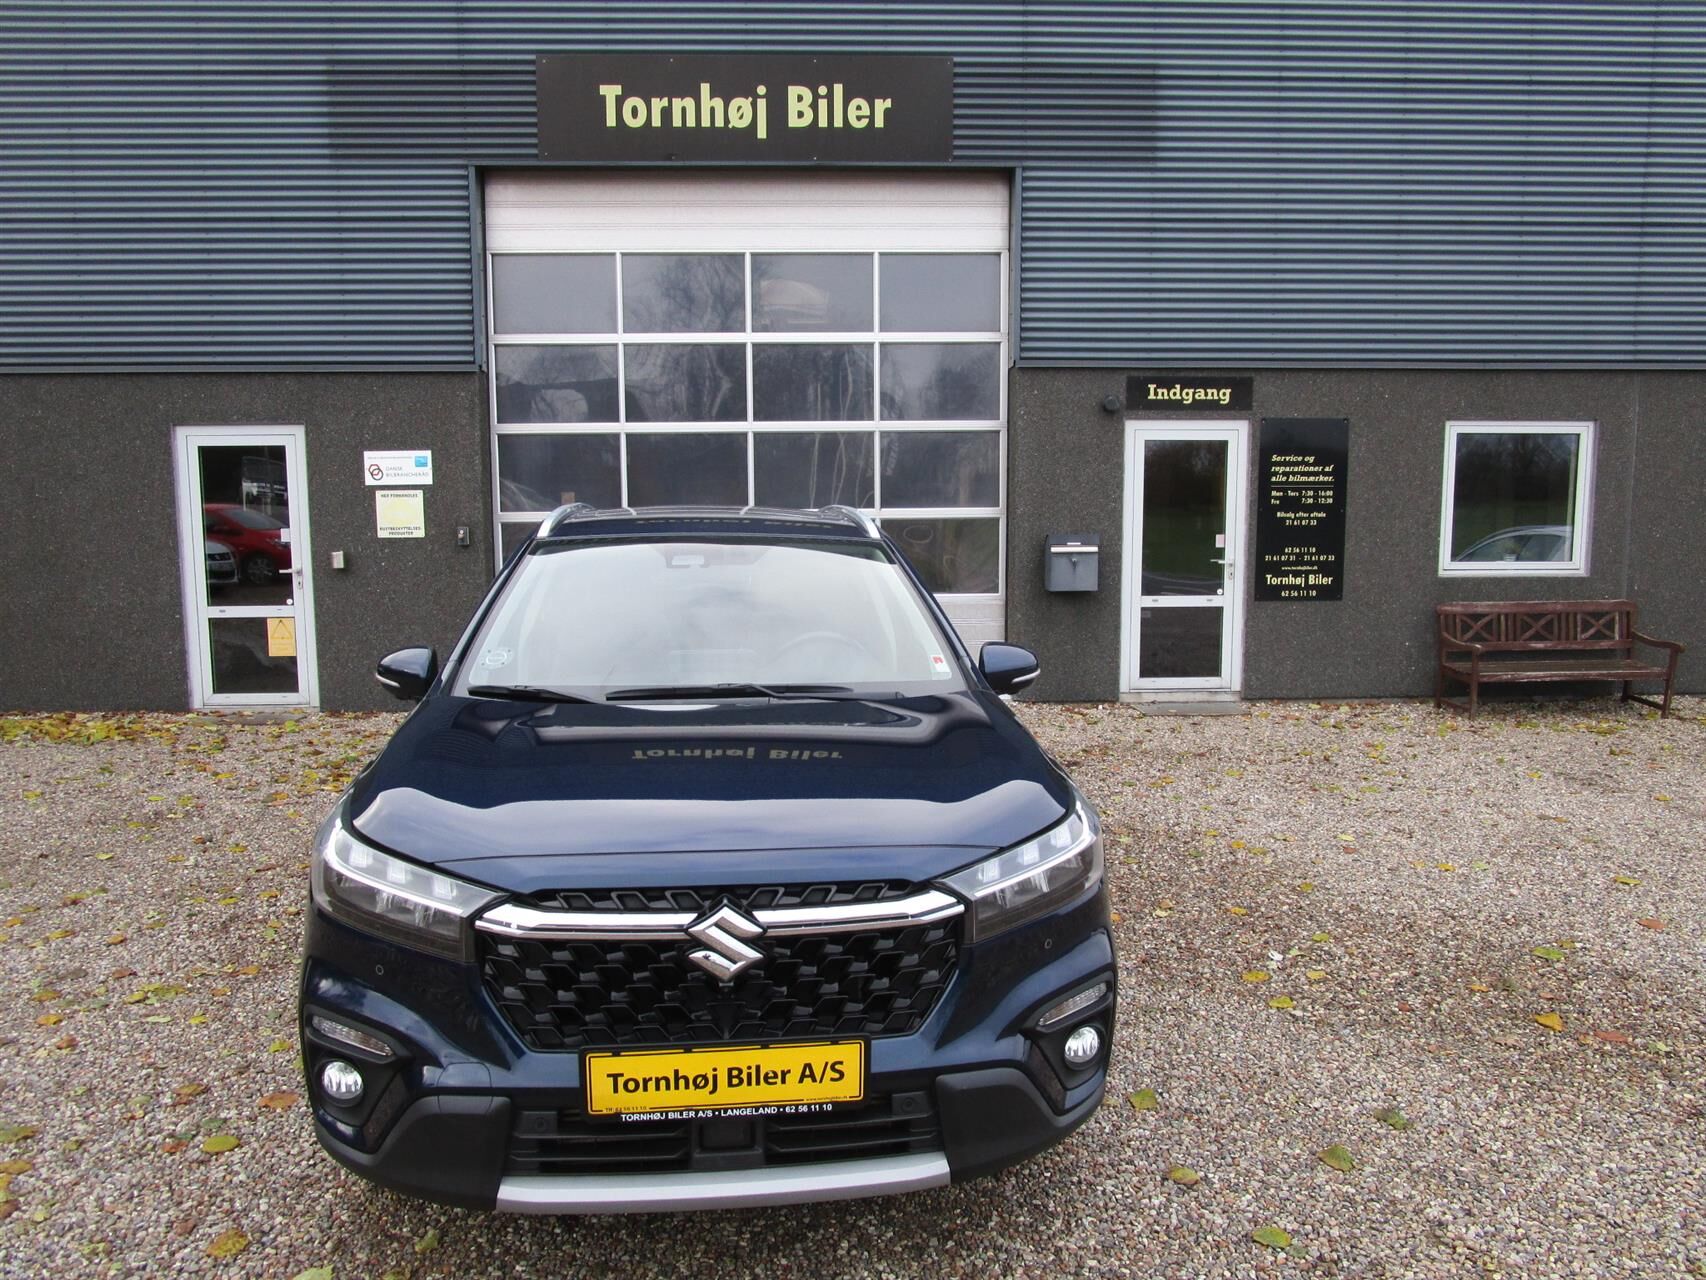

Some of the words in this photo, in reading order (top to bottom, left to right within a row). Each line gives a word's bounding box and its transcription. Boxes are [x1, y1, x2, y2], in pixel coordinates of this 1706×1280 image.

[599, 83, 767, 139] Tornhøj
[787, 83, 892, 128] Biler
[1147, 384, 1232, 404] Indgang
[1271, 454, 1302, 462] Service
[1271, 465, 1323, 473] reparationer
[1324, 464, 1334, 472] af
[1288, 474, 1335, 482] bilmærker.
[1265, 574, 1305, 587] Tornhøj
[1308, 574, 1333, 585] Biler
[606, 1067, 718, 1095] Tornhøj
[727, 1064, 791, 1089] Biler
[797, 1060, 846, 1084] A/S
[621, 1112, 666, 1122] TORNHØJ
[668, 1110, 696, 1119] BILER
[698, 1109, 713, 1118] A/S
[721, 1106, 778, 1117] LANGELAND
[785, 1105, 796, 1113] 62
[798, 1104, 808, 1112] 56
[810, 1104, 819, 1112] 11
[823, 1103, 832, 1111] 10
